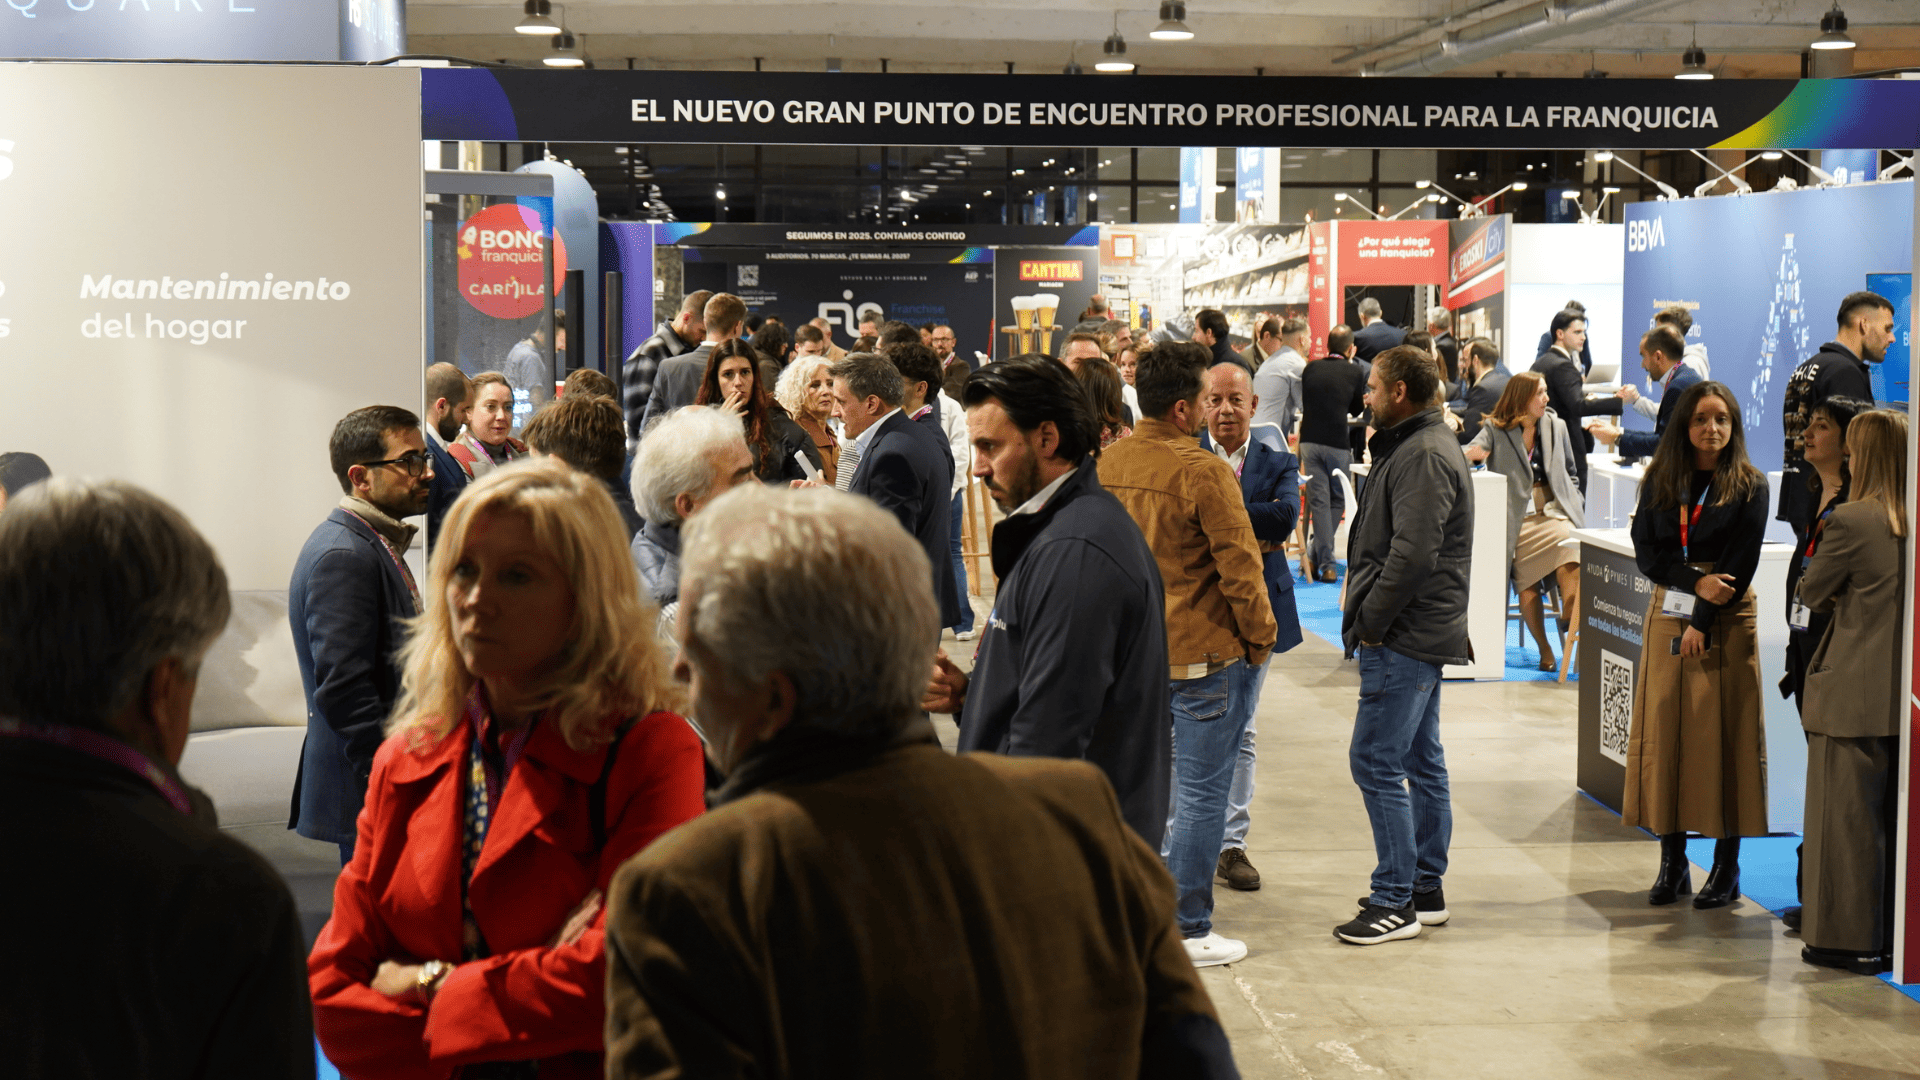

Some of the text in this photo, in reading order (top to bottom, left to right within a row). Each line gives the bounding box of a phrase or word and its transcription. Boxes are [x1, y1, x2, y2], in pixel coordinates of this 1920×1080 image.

[631, 98, 1719, 132] EL NUEVO GRAN PUNTO DE ENCUENTRO PROFESIONAL PARA LA FRANQUICIA
[785, 231, 967, 241] SEGUIMOS EN 2025. CONTAMOS CONTIGO
[1358, 235, 1432, 249] ¿Por qué elegir
[1628, 215, 1666, 252] BBVA
[481, 249, 544, 265] franquici
[811, 252, 820, 261] 70
[819, 252, 847, 261] MARCAS.
[860, 252, 882, 261] SUMAS
[882, 252, 891, 261] AL
[1358, 247, 1436, 260] una franquicia?
[1459, 236, 1484, 273] EROSKI
[79, 271, 351, 301] Mantenimiento
[80, 311, 248, 346] del hogar
[1587, 563, 1603, 578] AYUDA
[1610, 570, 1628, 586] PYMES
[1634, 577, 1652, 594] BBVA
[1593, 595, 1617, 617] Comienza
